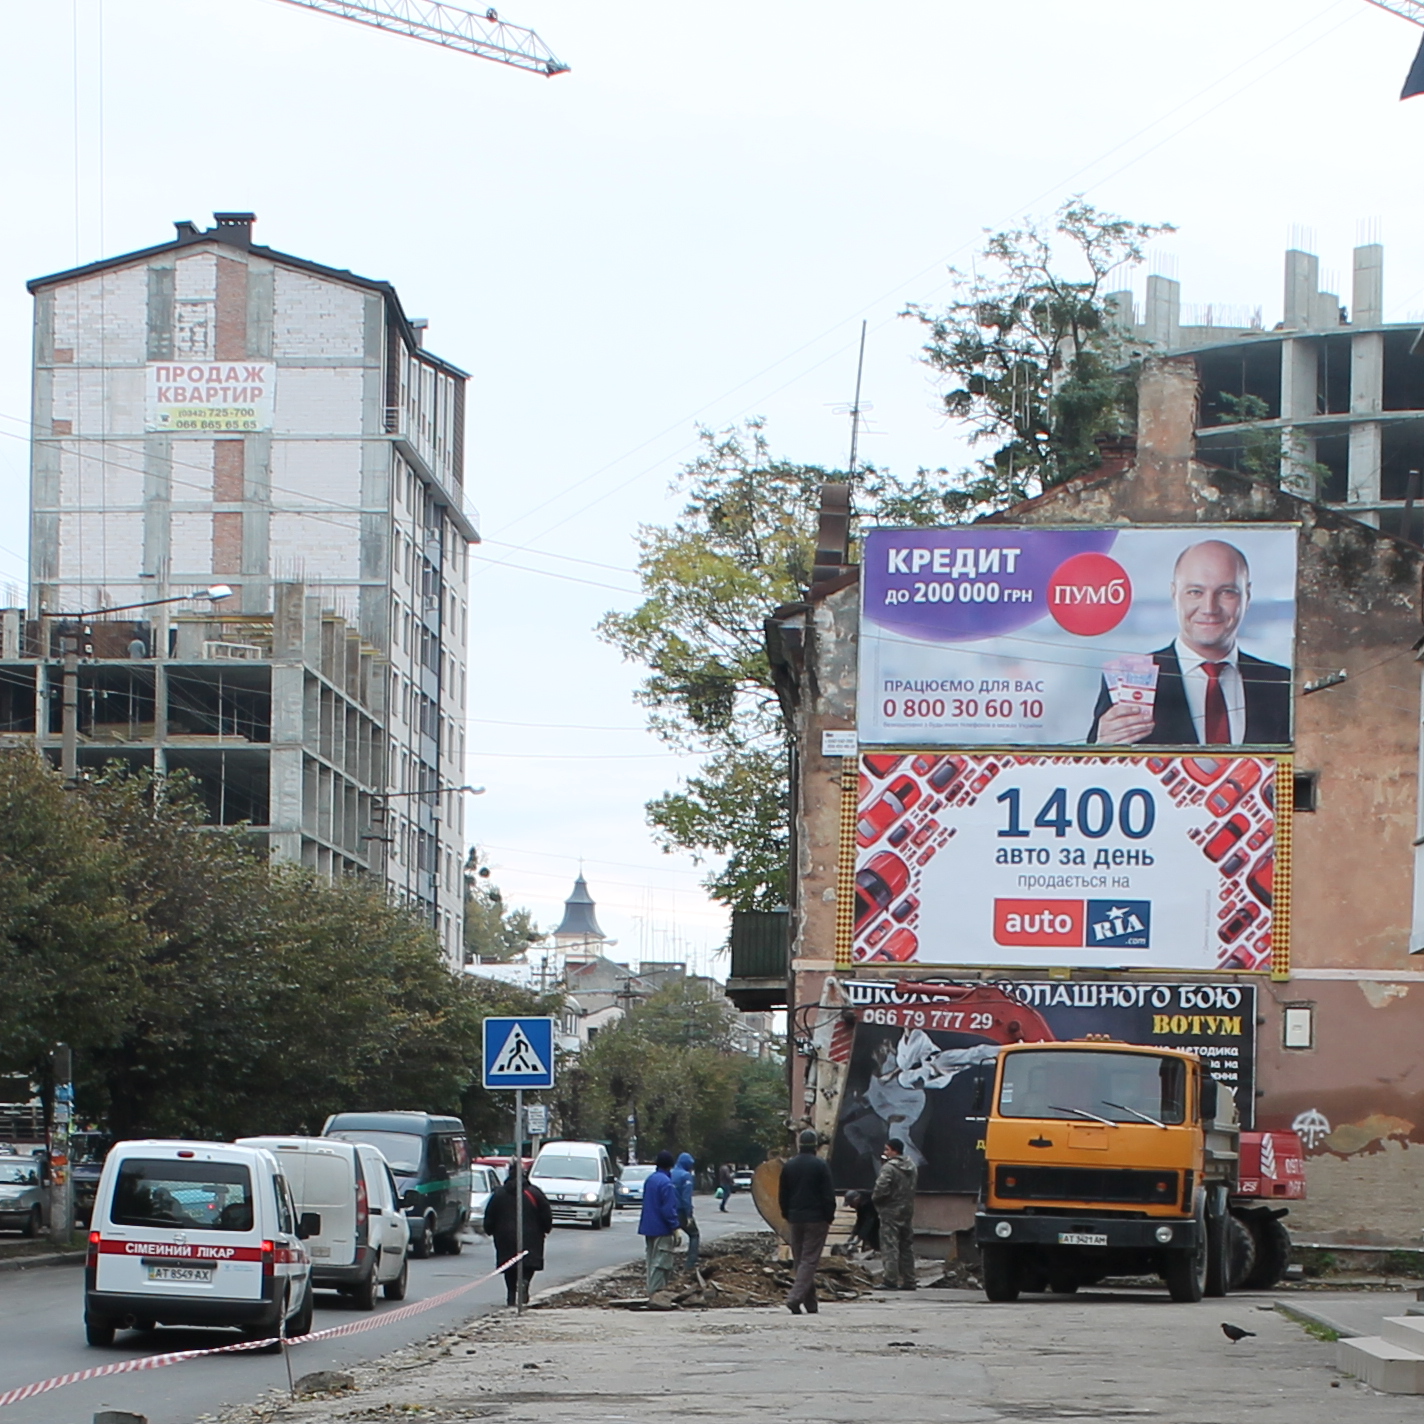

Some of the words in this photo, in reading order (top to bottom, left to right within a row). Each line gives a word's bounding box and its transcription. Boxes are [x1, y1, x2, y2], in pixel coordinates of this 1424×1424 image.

[155, 366, 265, 385] ПРОДАЖ
[157, 386, 264, 404] КВАРТИР
[208, 408, 255, 417] 725-700
[887, 548, 1022, 578] КРЕДИТ
[913, 582, 955, 603] 200
[958, 582, 1000, 603] 000
[884, 680, 974, 693] ПРАЦЮЄМО
[978, 680, 1010, 694] ДЛЯ
[1015, 680, 1044, 693] ВАС
[883, 699, 897, 717] 0
[903, 699, 945, 718] 800
[951, 699, 978, 718] 30
[985, 699, 1013, 718] 60
[1019, 699, 1044, 718] 10
[996, 787, 1155, 838] 1400
[995, 847, 1050, 865] авто
[1058, 847, 1085, 865] за
[1093, 848, 1154, 870] день
[1018, 874, 1107, 890] продається
[1112, 876, 1130, 888] на
[1005, 910, 1073, 934] auto
[1092, 914, 1145, 941] RIA
[1178, 986, 1243, 1009] БОЮ
[863, 1009, 897, 1025] 066
[902, 1010, 925, 1027] 79
[930, 1010, 965, 1028] 777
[970, 1013, 993, 1030] 29
[1152, 1014, 1243, 1035] ВОТУМ
[125, 1242, 192, 1257] СІМЕЙНИЙ
[196, 1247, 235, 1259] ЛІКАР
[171, 1268, 193, 1279] 8549
